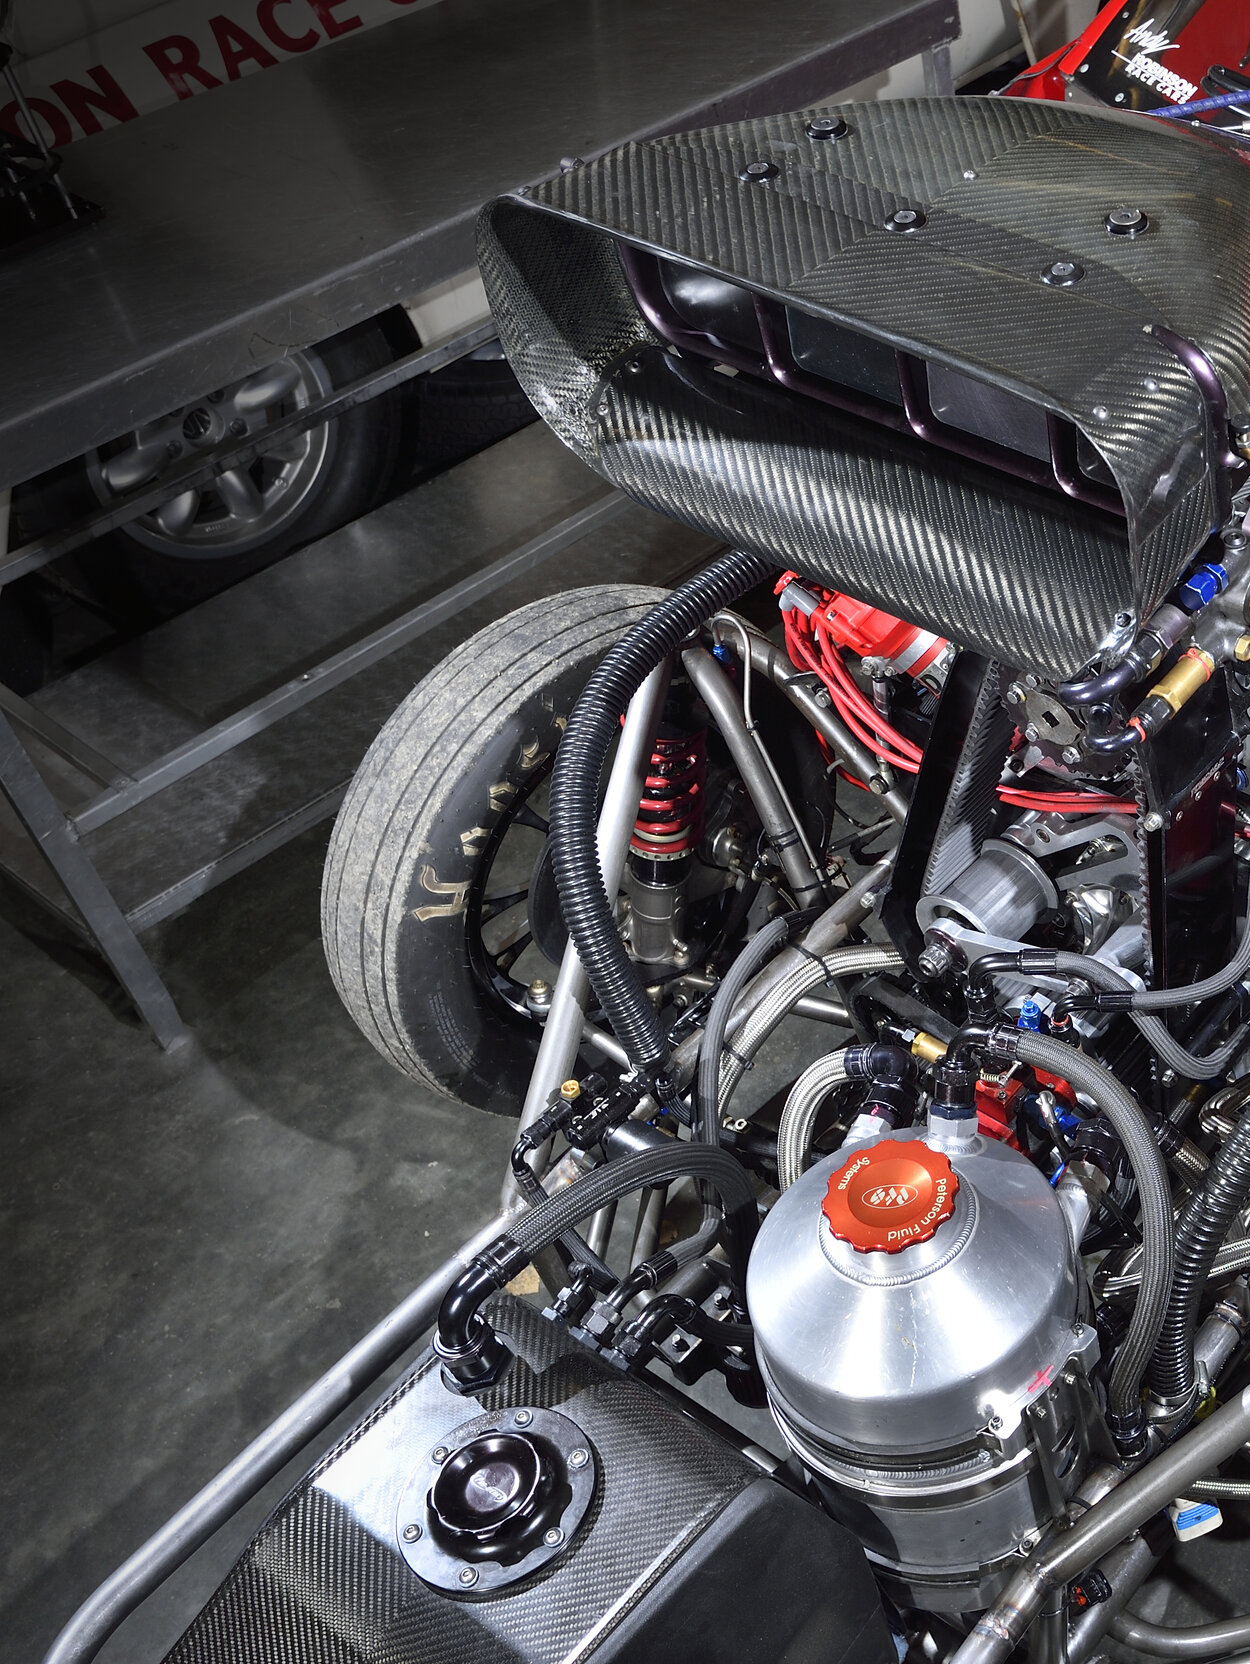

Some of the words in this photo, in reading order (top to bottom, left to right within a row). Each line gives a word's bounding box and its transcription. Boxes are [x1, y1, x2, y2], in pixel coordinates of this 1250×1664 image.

[142, 0, 363, 100] RACE
[1123, 18, 1180, 54] Andy
[1124, 63, 1157, 86] RACE
[1156, 81, 1189, 104] CARS
[1130, 52, 1198, 98] ROBINSON
[837, 1156, 871, 1191] Systems
[919, 1177, 948, 1226] Peterson
[887, 1223, 922, 1242] Fluid
